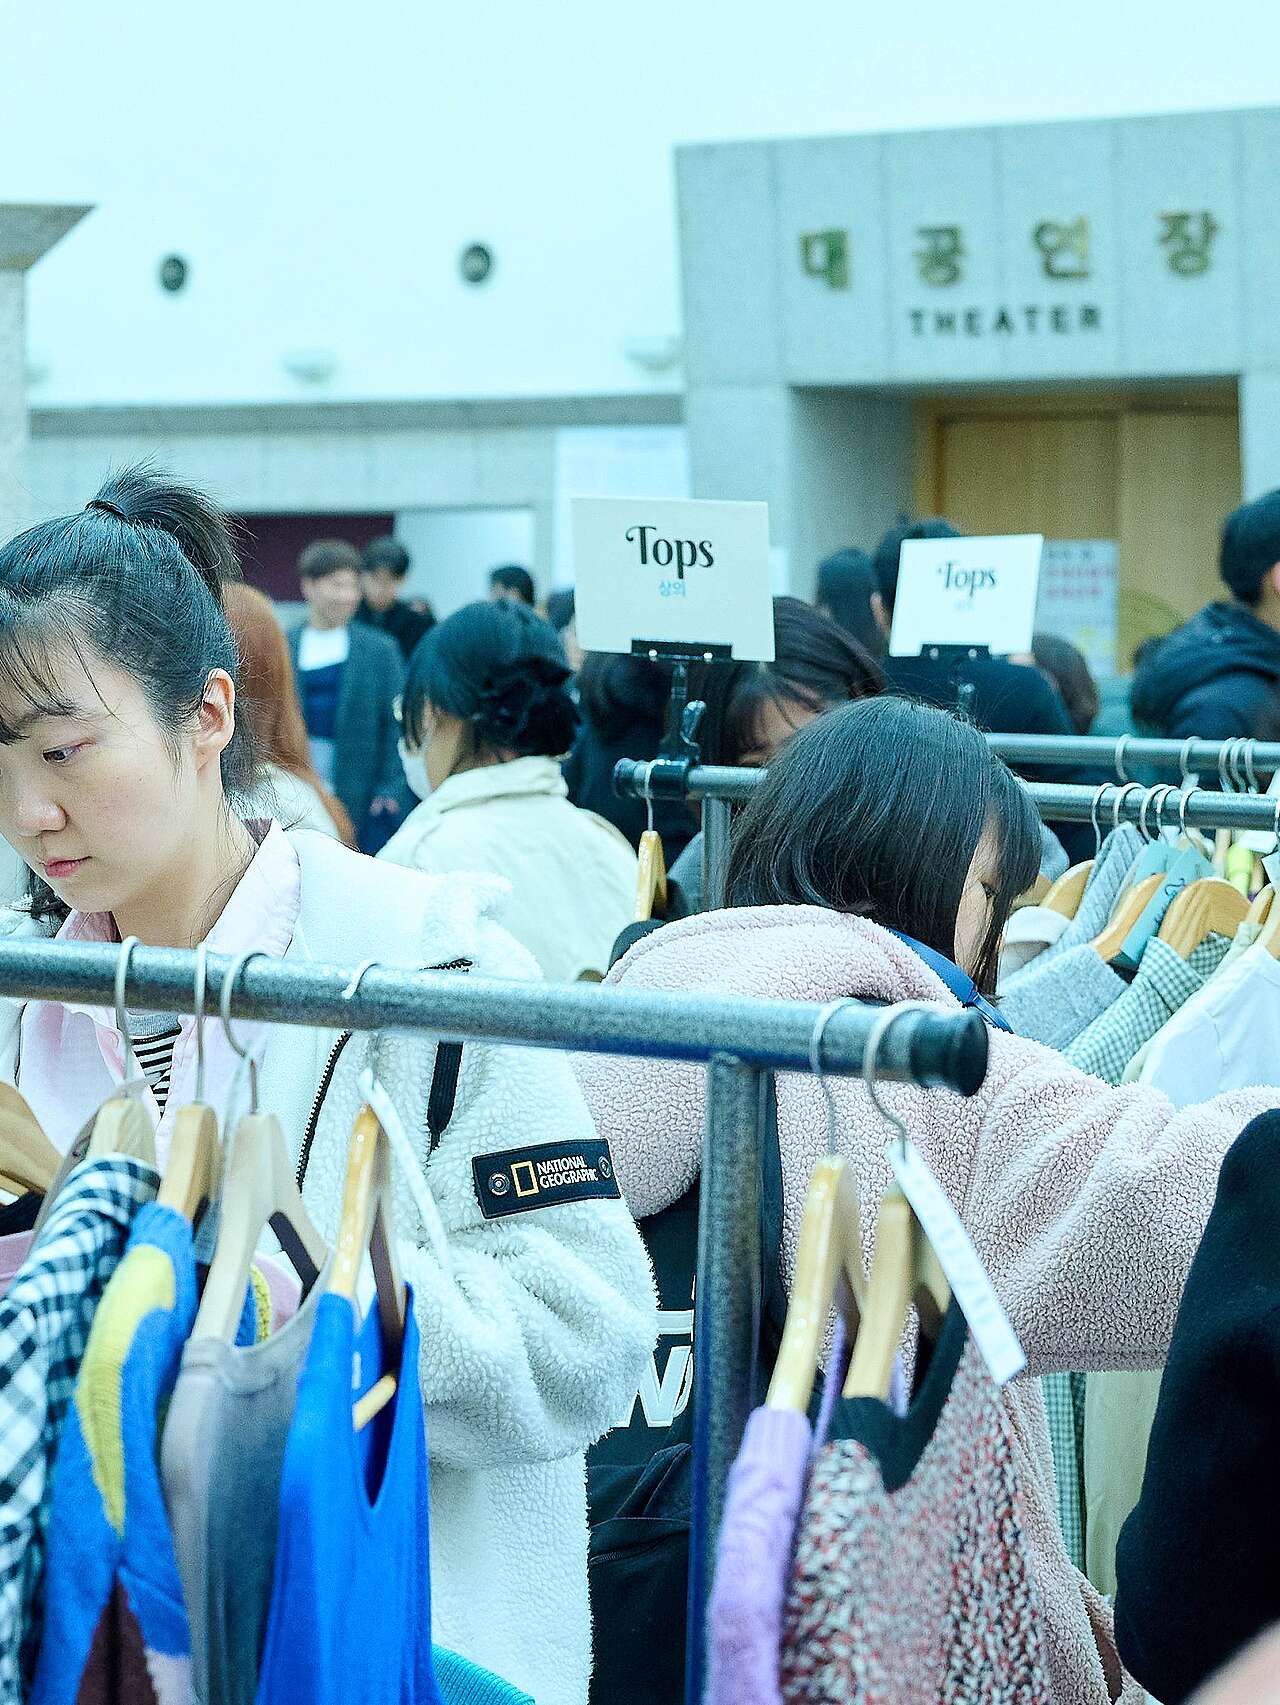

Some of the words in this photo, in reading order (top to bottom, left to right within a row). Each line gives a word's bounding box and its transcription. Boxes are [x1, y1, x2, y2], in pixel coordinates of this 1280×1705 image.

[909, 304, 1101, 337] THEATER
[625, 525, 714, 579] Tops
[659, 580, 687, 598] 상의
[937, 560, 996, 598] Tops
[536, 1155, 588, 1176] NATIONAL
[539, 1168, 599, 1189] GEOGRAPHIC
